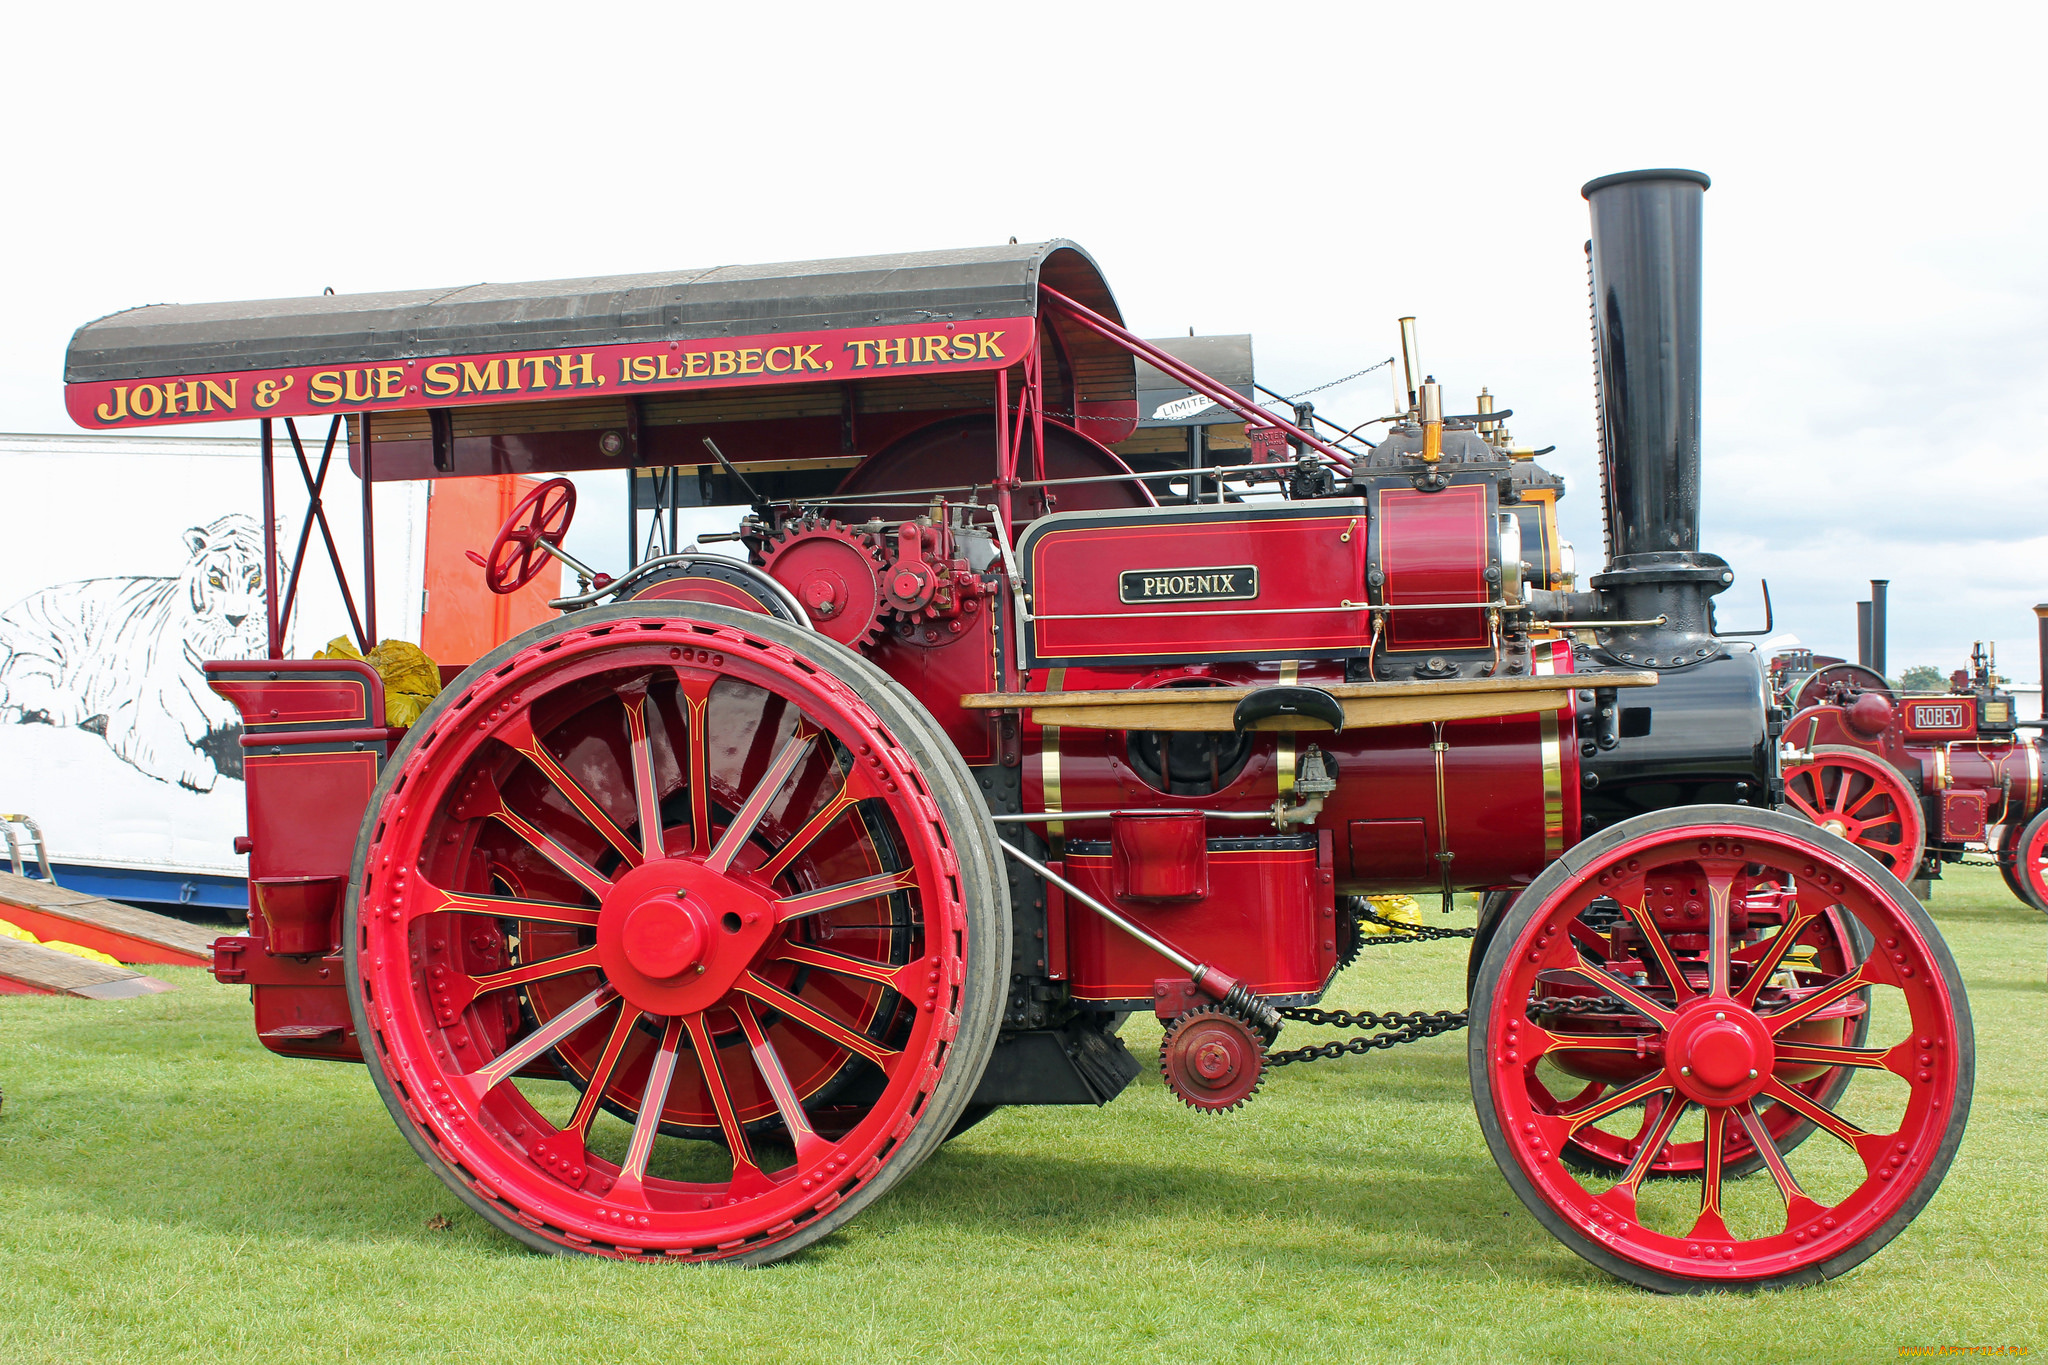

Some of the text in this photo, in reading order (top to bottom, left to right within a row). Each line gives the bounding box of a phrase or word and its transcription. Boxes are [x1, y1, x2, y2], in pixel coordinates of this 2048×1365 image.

[97, 330, 1006, 421] JOHN & SUE SMITH, ISLEBECK, THIRSK
[1252, 431, 1285, 441] FOSTER
[1142, 574, 1235, 596] PHOENIX
[1917, 707, 1960, 726] ROBEY
